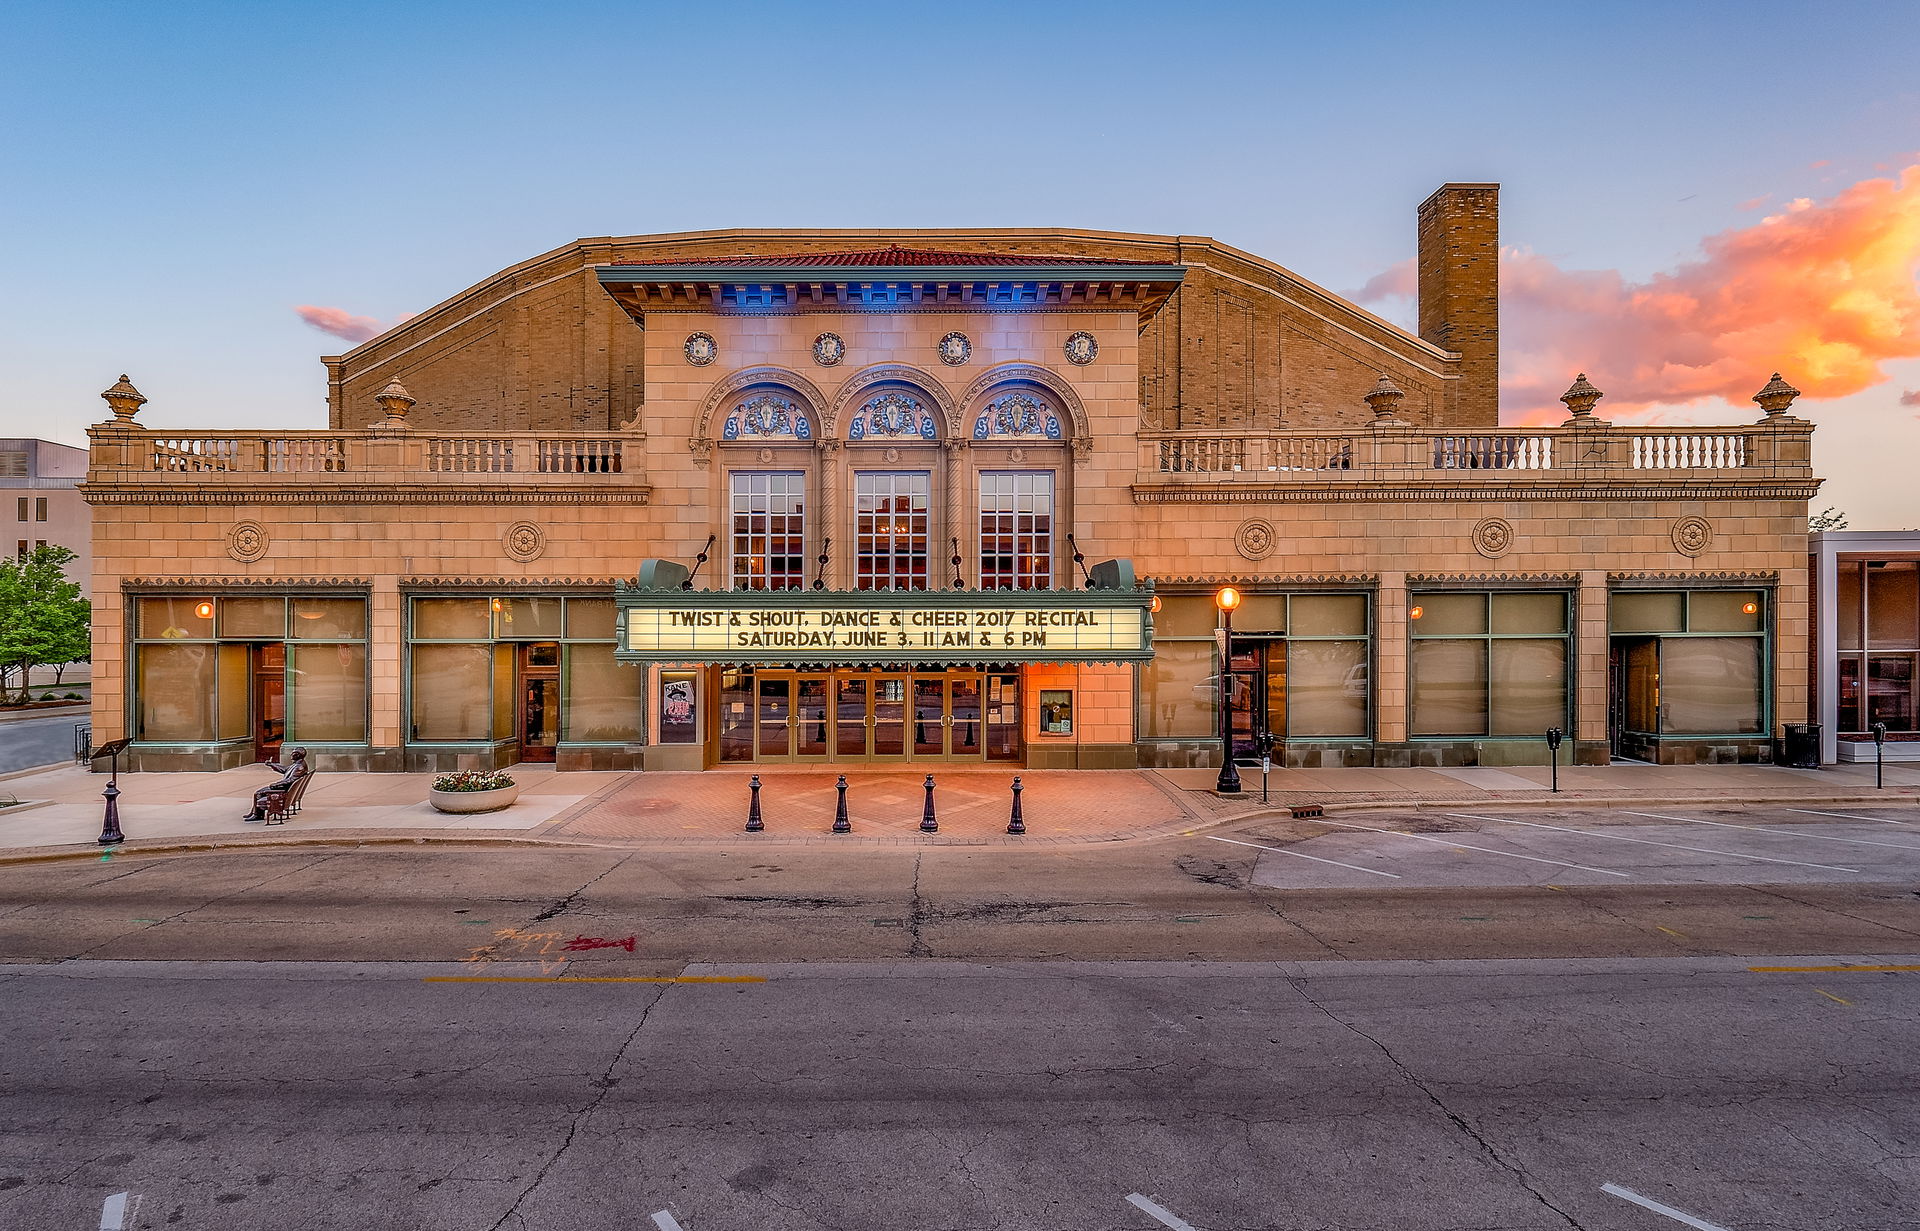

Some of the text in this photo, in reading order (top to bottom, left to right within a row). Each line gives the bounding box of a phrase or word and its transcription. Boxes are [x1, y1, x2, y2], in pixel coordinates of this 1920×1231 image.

[668, 611, 1099, 627] TWIST & SHOUT, DANCE & CHEER 2017 RECITAL
[737, 631, 1047, 647] SATURDAY, JUNE 3, 11 AM & 6 PM
[665, 682, 688, 691] KANE
